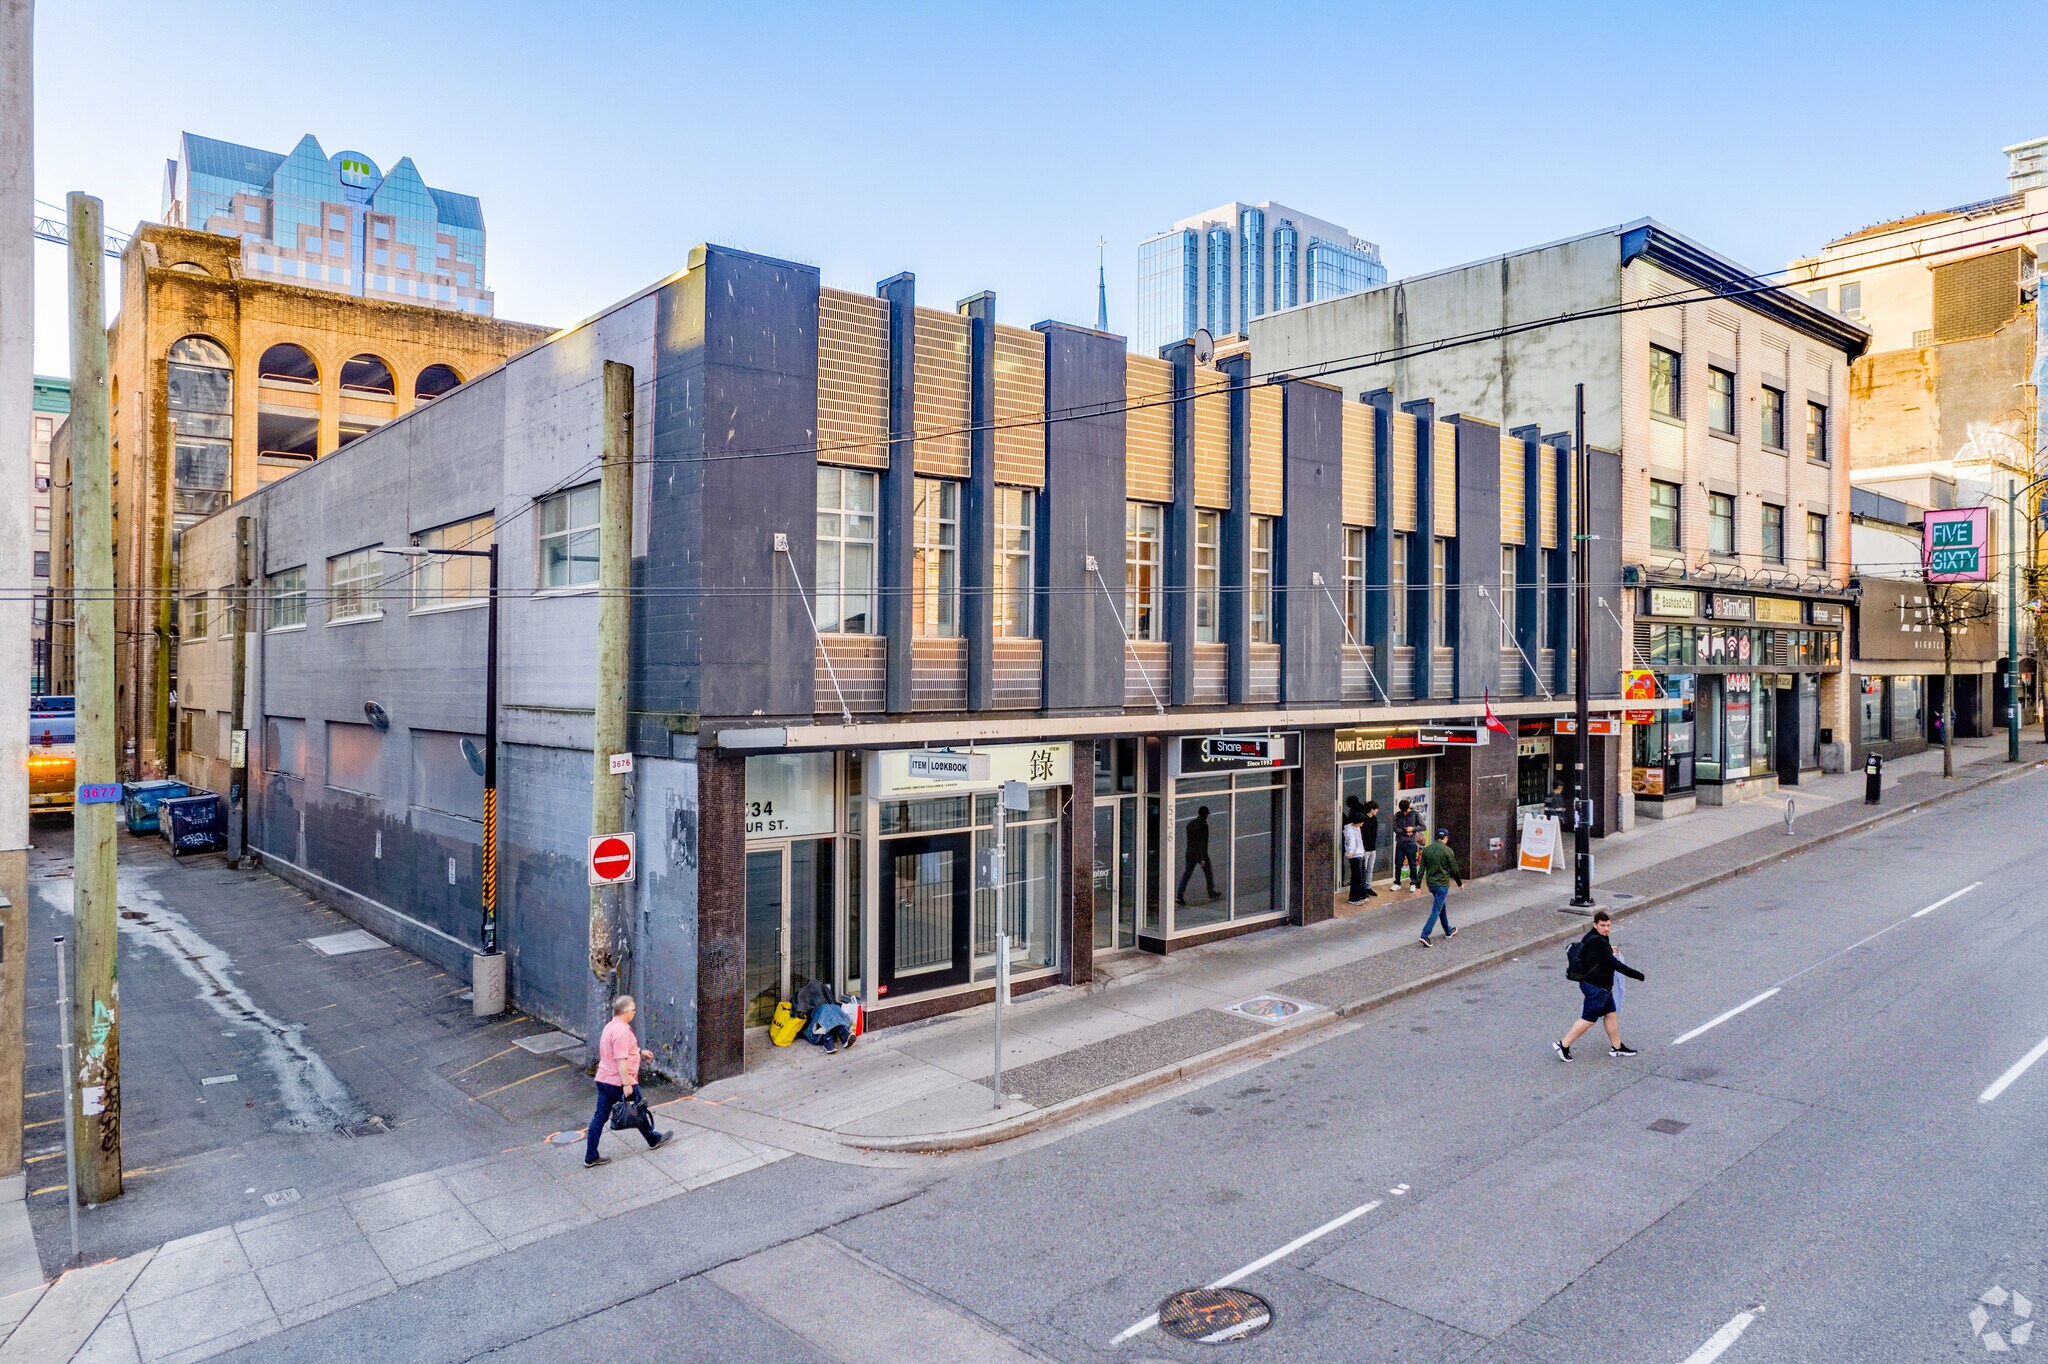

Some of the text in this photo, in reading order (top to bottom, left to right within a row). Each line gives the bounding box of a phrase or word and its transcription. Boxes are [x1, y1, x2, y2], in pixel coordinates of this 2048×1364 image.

[1933, 523, 1968, 543] FIVE
[1932, 550, 1978, 570] SIXTY
[1217, 740, 1256, 752] Sharetea
[1335, 738, 1355, 752] OUNT
[1356, 737, 1386, 751] EVEREST
[612, 758, 631, 769] 3676
[912, 760, 927, 770] ITEM
[82, 787, 116, 799] 3677
[769, 820, 788, 831] ST.
